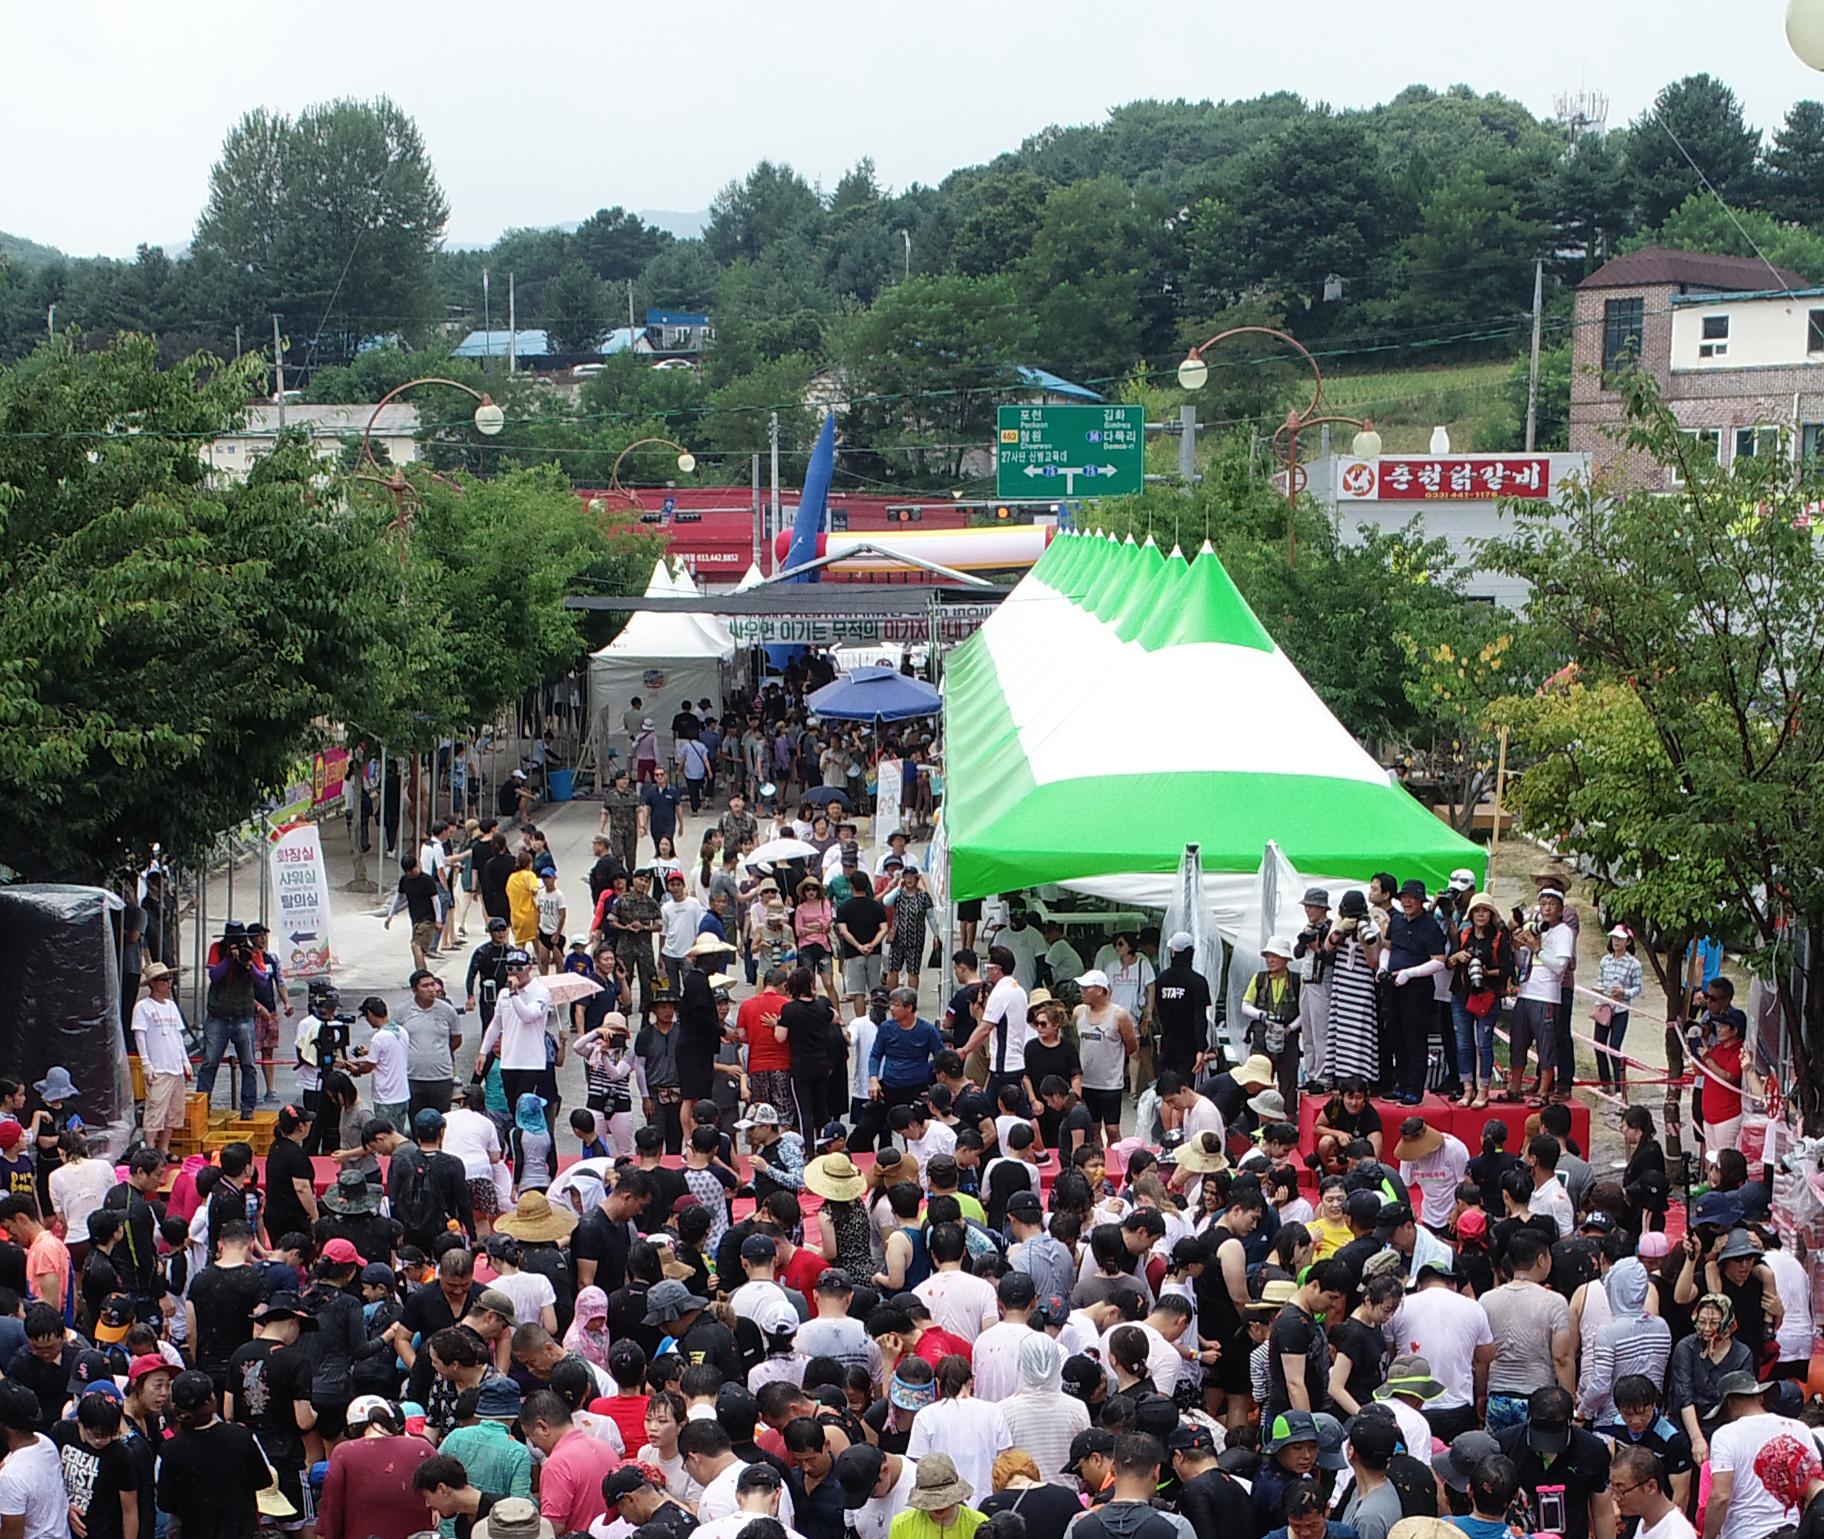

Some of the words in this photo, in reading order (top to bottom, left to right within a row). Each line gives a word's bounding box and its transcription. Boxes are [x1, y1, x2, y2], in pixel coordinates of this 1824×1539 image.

[1020, 409, 1042, 421] 포천
[1104, 409, 1125, 421] 김화
[1104, 430, 1136, 442] 다목리
[1384, 462, 1541, 491] 춘천닭갈비
[780, 620, 827, 642] 이기는
[832, 620, 878, 641] 무적의
[884, 619, 929, 641] 이기자
[277, 846, 314, 863] 화장실
[279, 868, 317, 886] 샤워실
[280, 892, 319, 909] 탈의실
[61, 1443, 100, 1473] CEREAL
